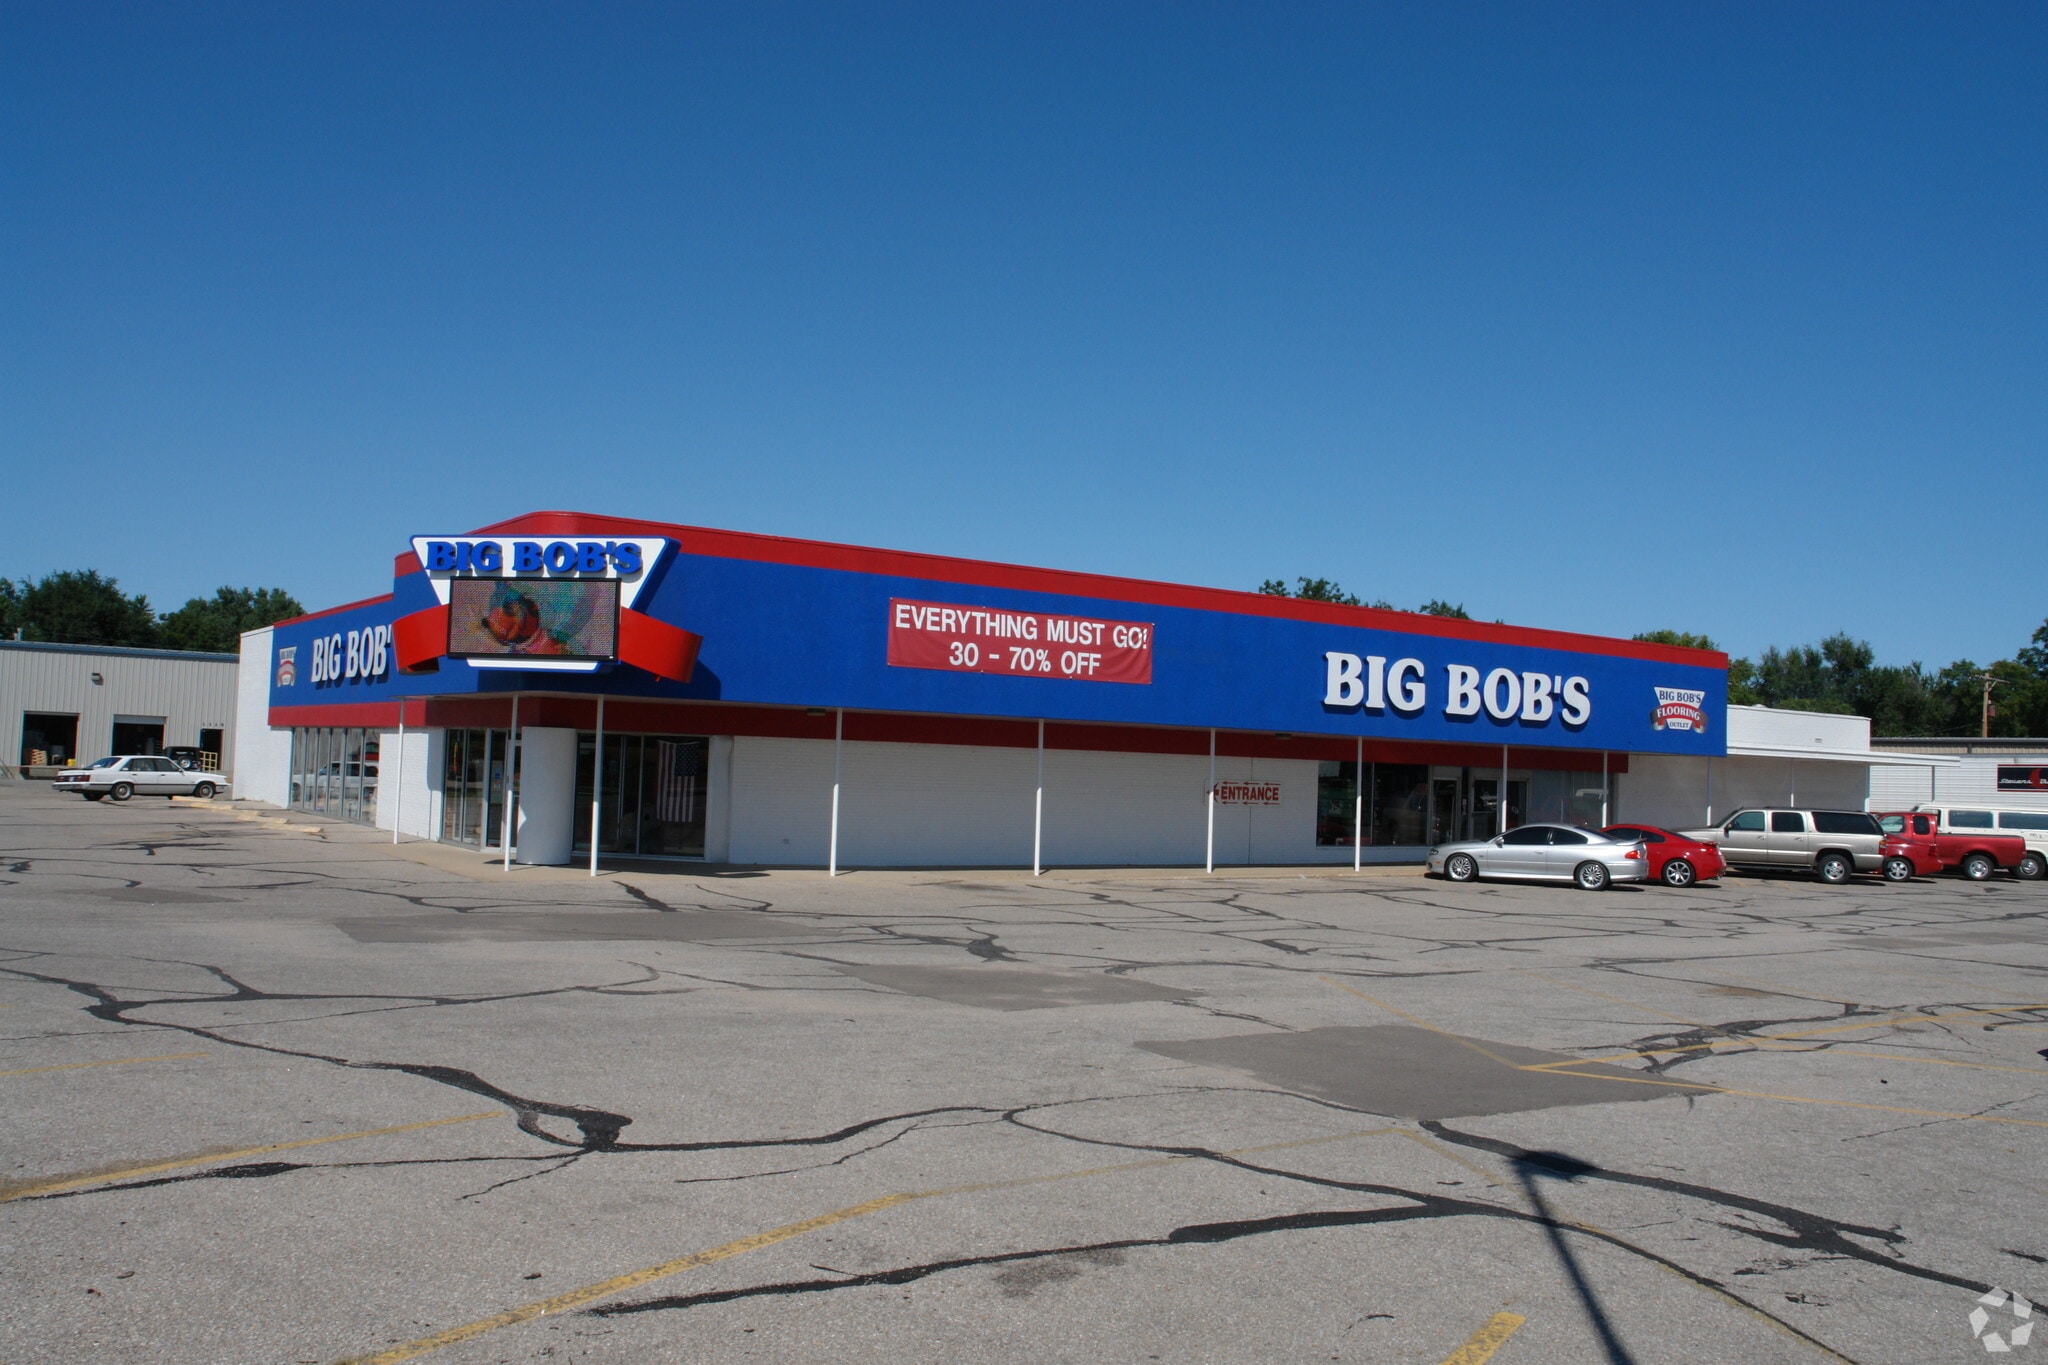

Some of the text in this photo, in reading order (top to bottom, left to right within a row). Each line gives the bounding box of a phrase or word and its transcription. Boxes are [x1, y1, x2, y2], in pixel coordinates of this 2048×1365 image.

[426, 541, 642, 574] BIG BOB'S
[895, 604, 1149, 650] EVERYTHING MUST GO!
[311, 633, 342, 683] BIG
[949, 641, 979, 667] 30
[1008, 646, 1051, 673] 70%
[1060, 651, 1102, 676] OFF
[1324, 651, 1591, 726] BIG BOB'S
[1659, 690, 1701, 703] BIG BOB'S
[1656, 706, 1700, 721] FLOORING
[1220, 786, 1280, 801] ENTRANCE
